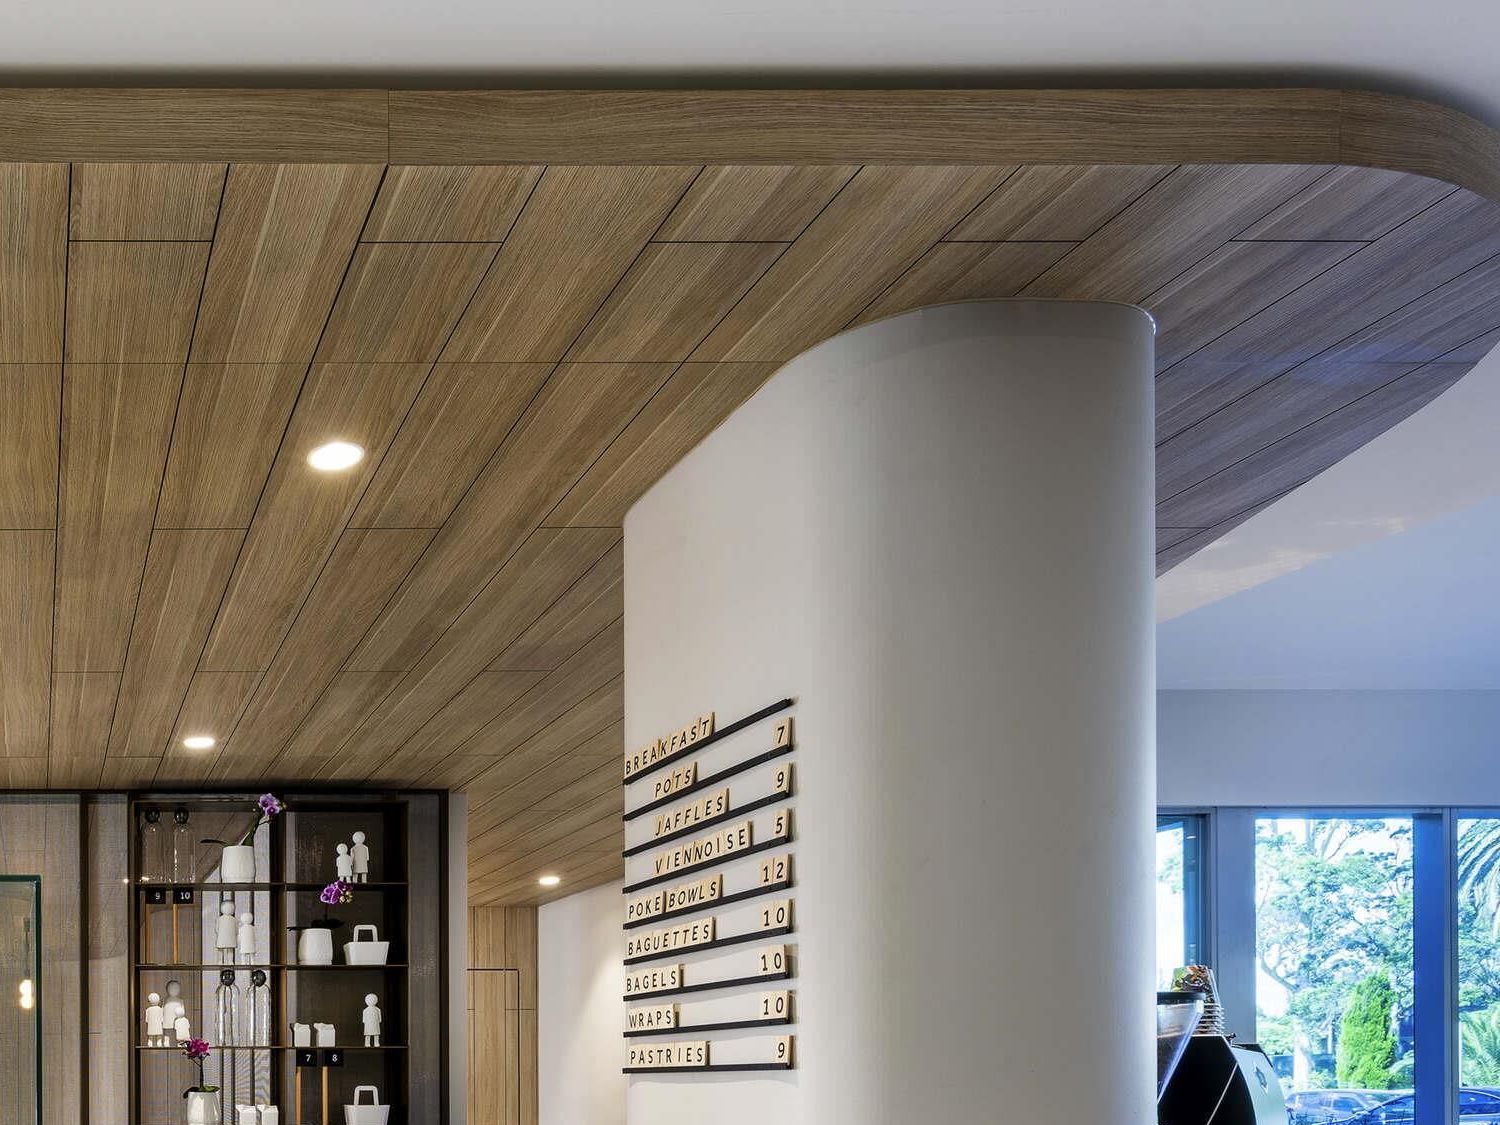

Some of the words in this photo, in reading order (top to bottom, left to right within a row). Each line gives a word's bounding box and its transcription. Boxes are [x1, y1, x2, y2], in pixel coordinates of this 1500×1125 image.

[625, 720, 709, 775] BREAKFAST
[655, 769, 691, 798] POTS
[777, 726, 785, 744] 7
[655, 796, 723, 836] JAFFLES
[776, 771, 784, 789] 9
[656, 828, 746, 874] VIENNOISE
[775, 817, 783, 834] 5
[180, 892, 191, 900] 10
[628, 896, 661, 919] POKE
[668, 881, 716, 908] BOWLS
[763, 862, 784, 882] 12
[628, 924, 709, 956] BAGUETTES
[763, 907, 785, 927] 10
[626, 970, 677, 992] BAGELS
[761, 952, 782, 972] 10
[628, 1010, 672, 1028] WRAPS
[763, 997, 784, 1016] 10
[630, 1047, 703, 1064] PASTRIES
[777, 1042, 785, 1059] 9
